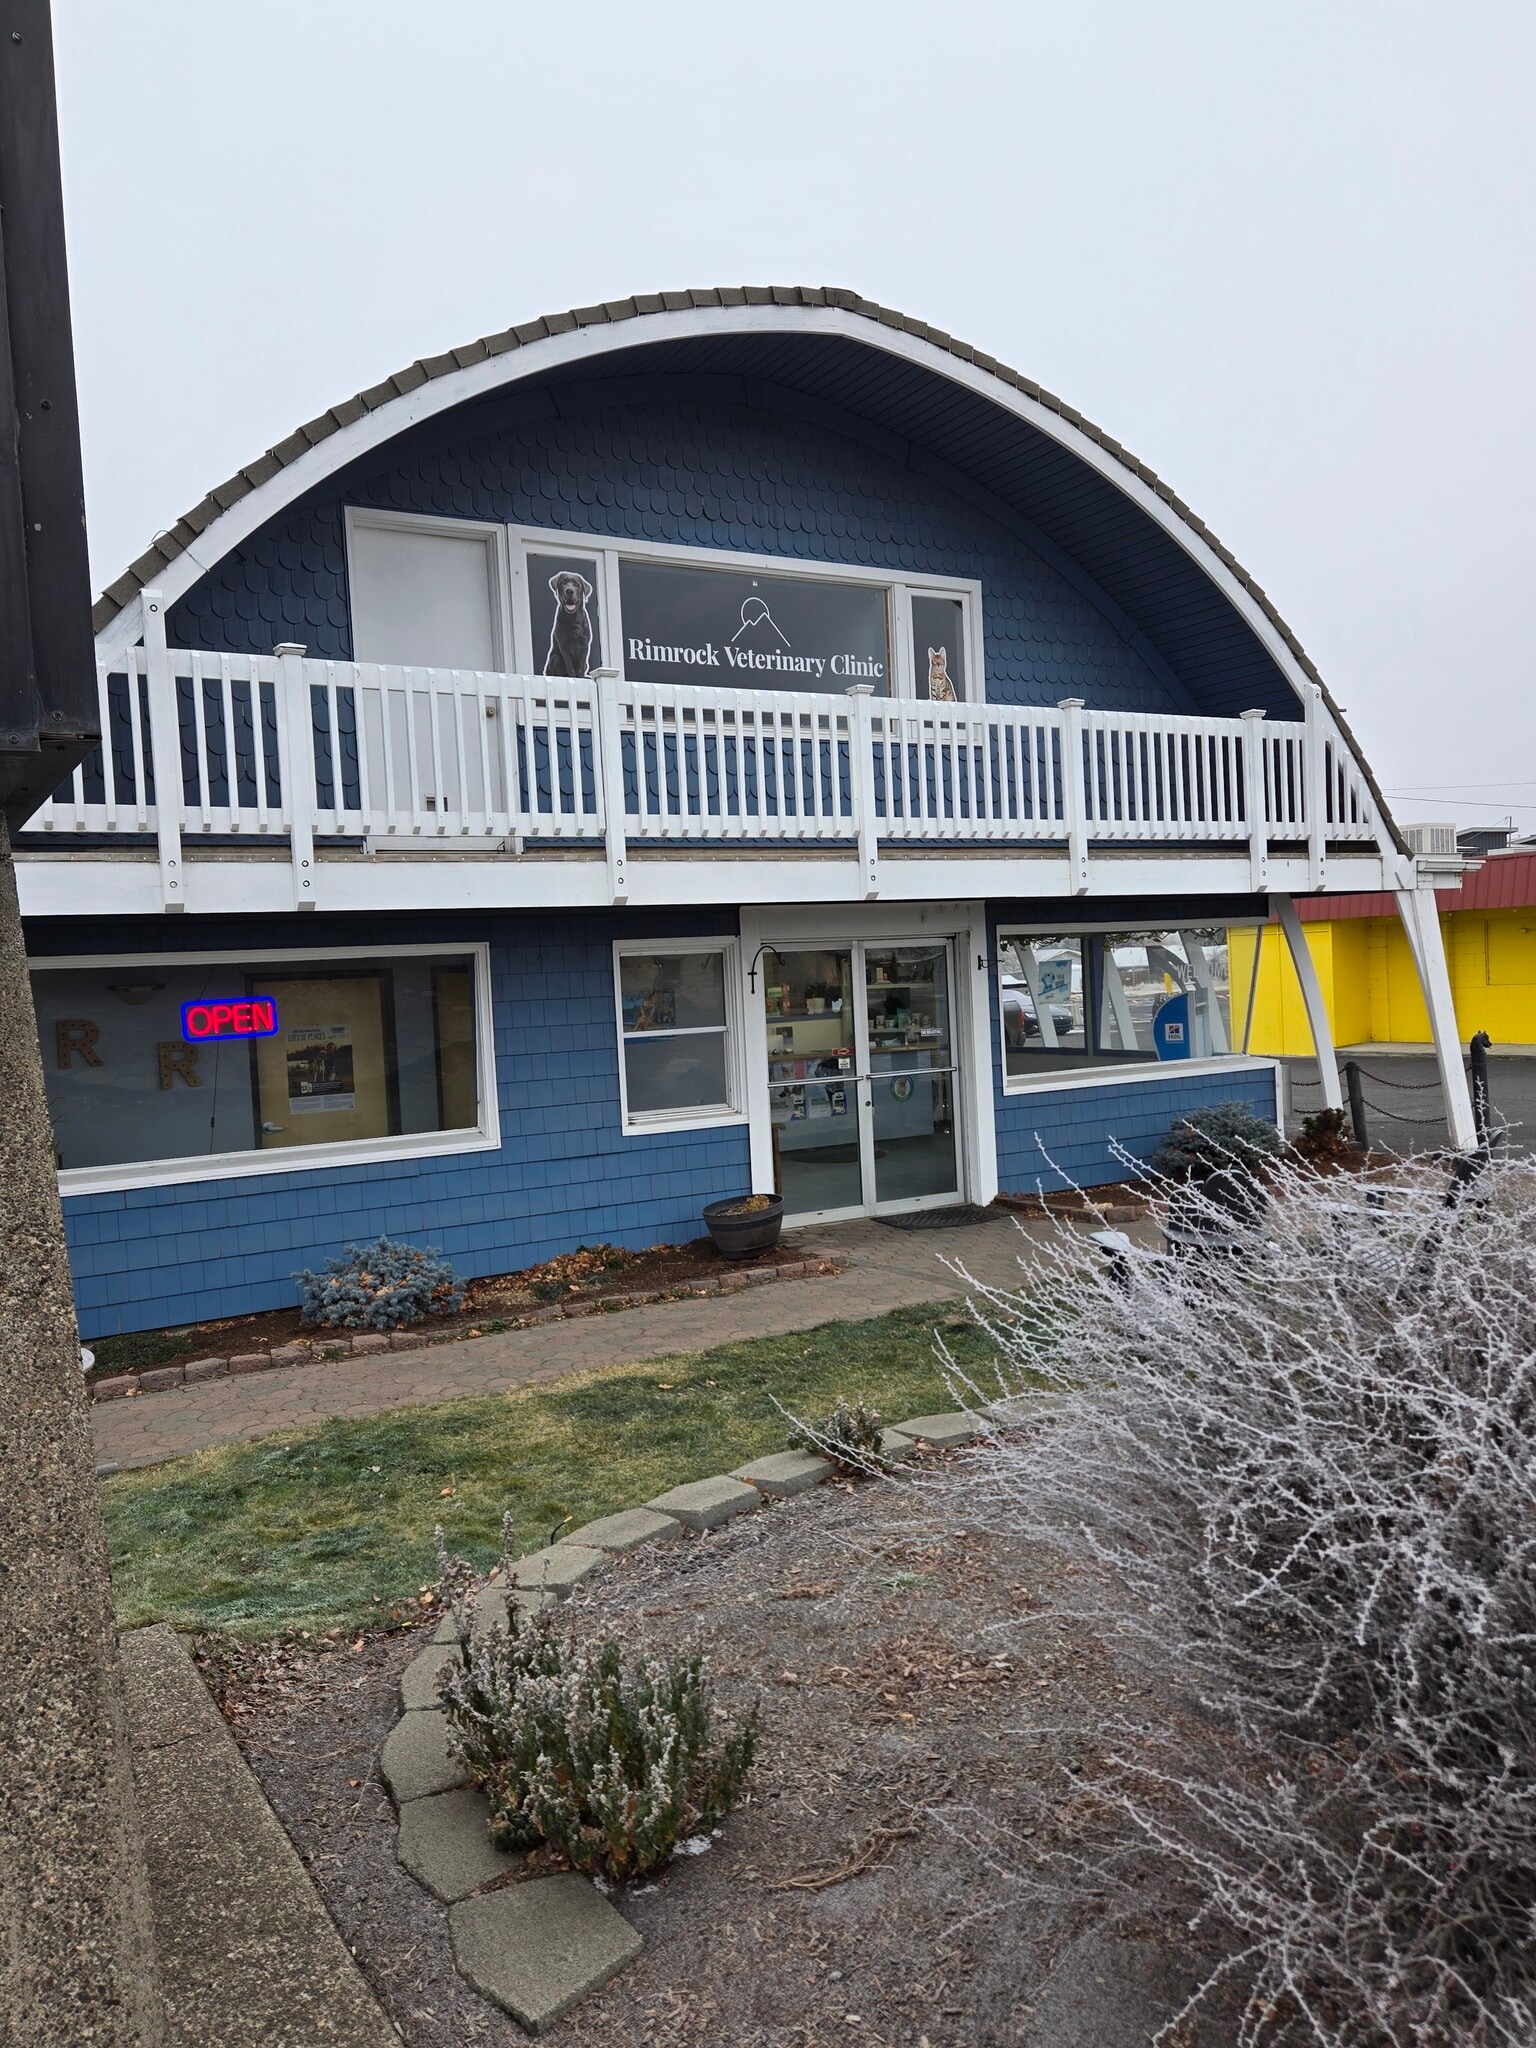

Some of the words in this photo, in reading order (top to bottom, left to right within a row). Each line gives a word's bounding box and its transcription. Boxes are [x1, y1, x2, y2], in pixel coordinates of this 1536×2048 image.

[628, 638, 720, 666] Rimrock
[723, 646, 826, 677] Veterinary
[830, 654, 884, 677] Clinic
[186, 1002, 273, 1036] OPEN
[56, 1019, 104, 1069] R
[157, 1041, 202, 1090] R
